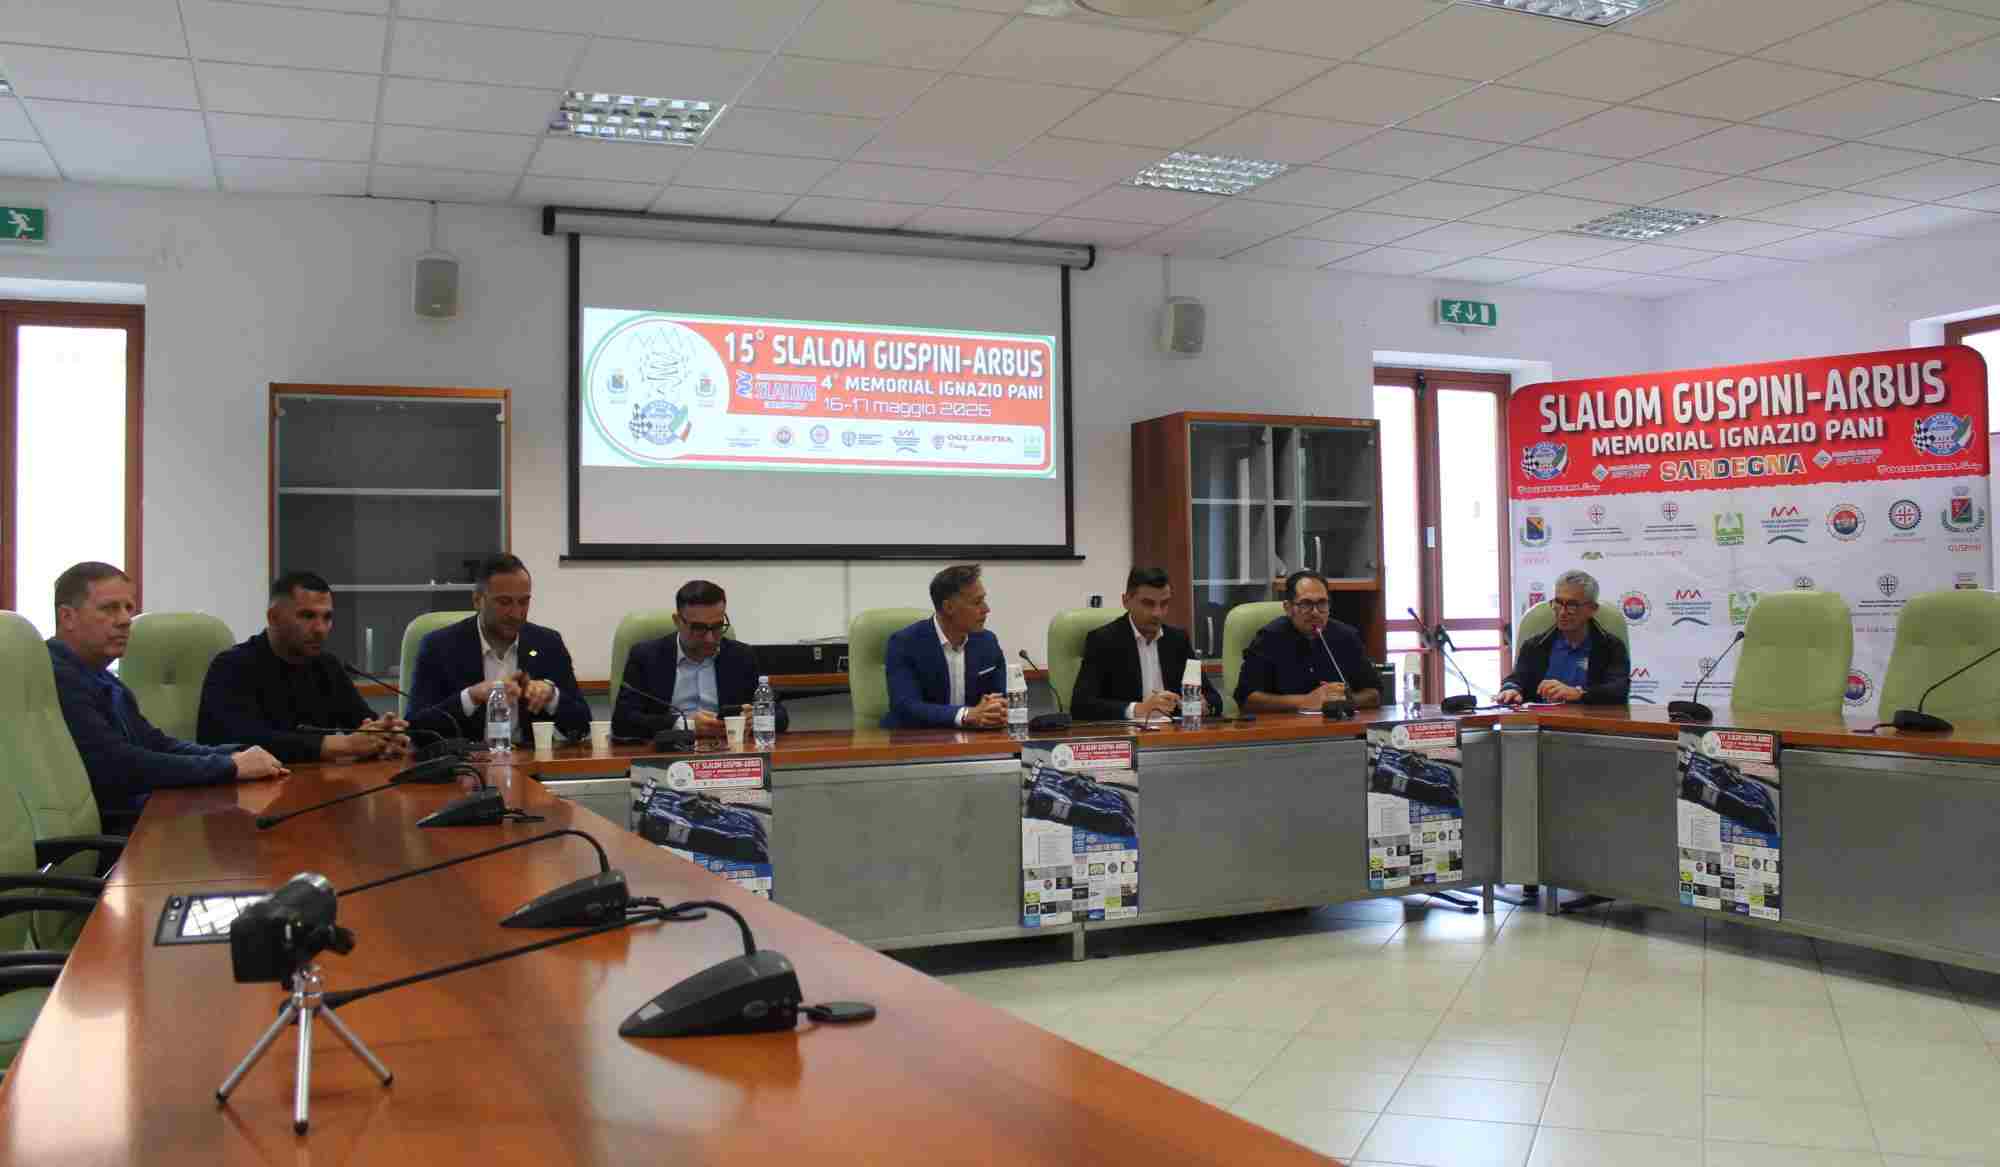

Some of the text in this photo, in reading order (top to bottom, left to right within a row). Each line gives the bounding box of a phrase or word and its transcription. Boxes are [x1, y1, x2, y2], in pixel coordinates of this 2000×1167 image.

[725, 331, 1044, 378] 15° SLALOM GUSPINI-ARBUS
[845, 376, 934, 395] MEMORIAL
[939, 379, 1003, 398] IGNAZIO
[1008, 384, 1044, 401] PANI
[1540, 360, 1946, 434] SLALOM GUSPINI-ARBUS
[873, 401, 936, 418] maggio
[1592, 417, 1885, 457] MEMORIAL IGNAZIO PANI
[1660, 453, 1808, 482] SARDEGNA
